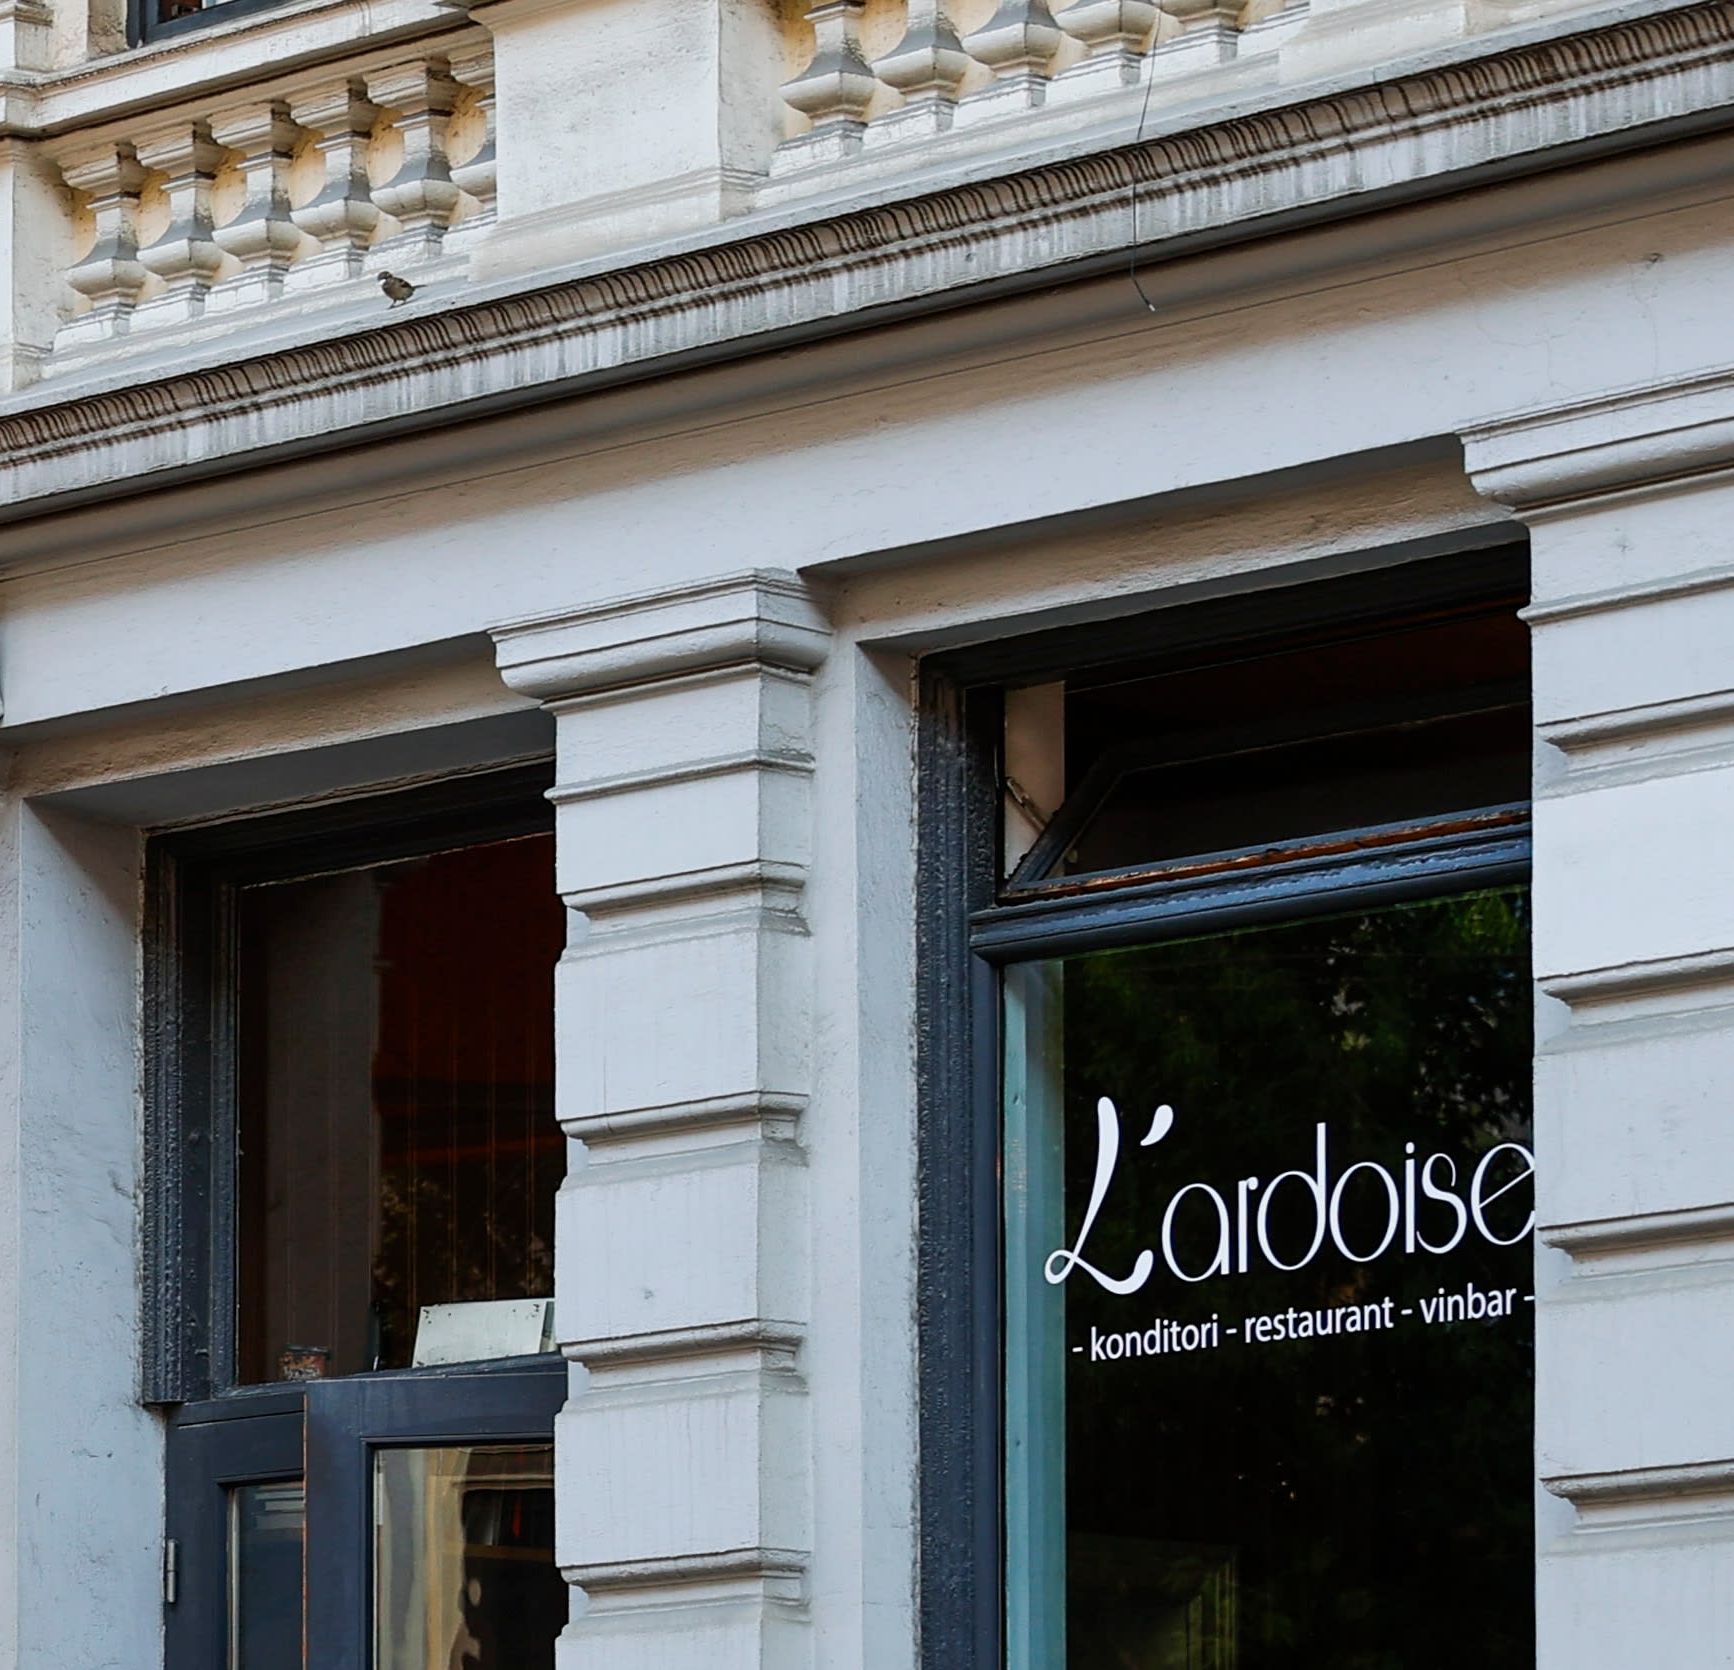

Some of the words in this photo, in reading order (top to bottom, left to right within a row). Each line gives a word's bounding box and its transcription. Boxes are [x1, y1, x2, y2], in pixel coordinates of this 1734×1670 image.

[1044, 1096, 1535, 1295] L'ardoise
[1090, 1313, 1219, 1362] konditori
[1244, 1296, 1394, 1344] restaurant
[1419, 1283, 1517, 1323] vinbar
